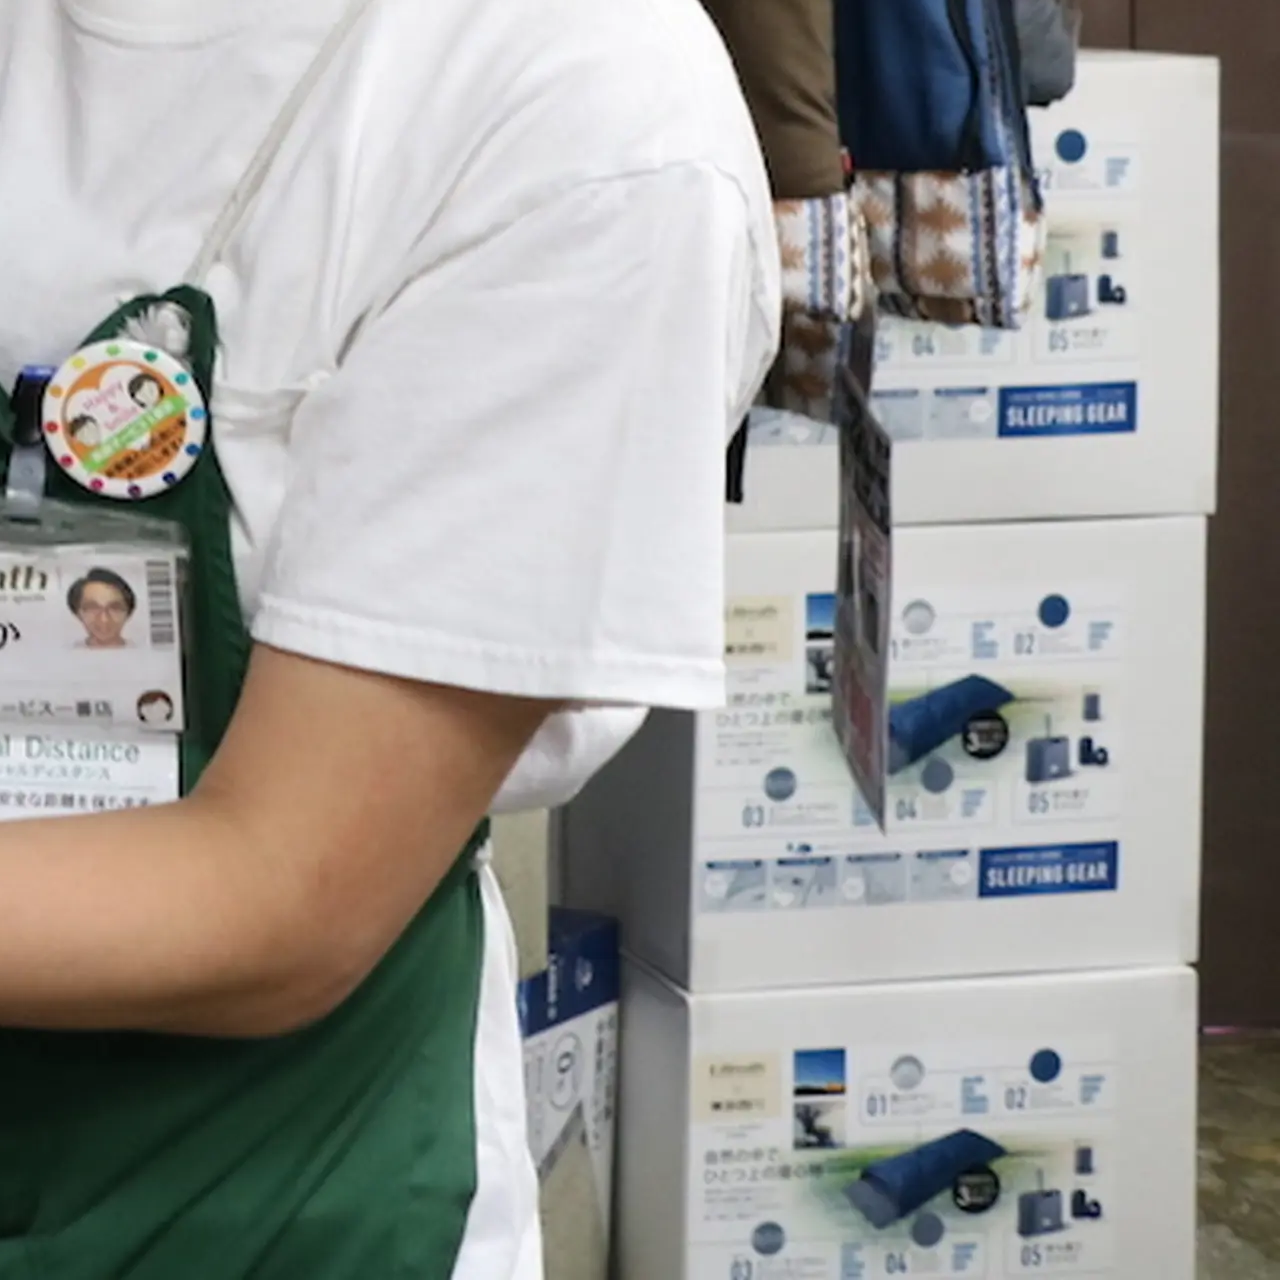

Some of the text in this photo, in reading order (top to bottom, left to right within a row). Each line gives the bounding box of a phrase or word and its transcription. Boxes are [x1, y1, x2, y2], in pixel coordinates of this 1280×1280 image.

[1006, 400, 1128, 429] SLEEPING GEAR
[24, 734, 142, 764] Distance
[986, 860, 1110, 889] SLEEPING GEAR
